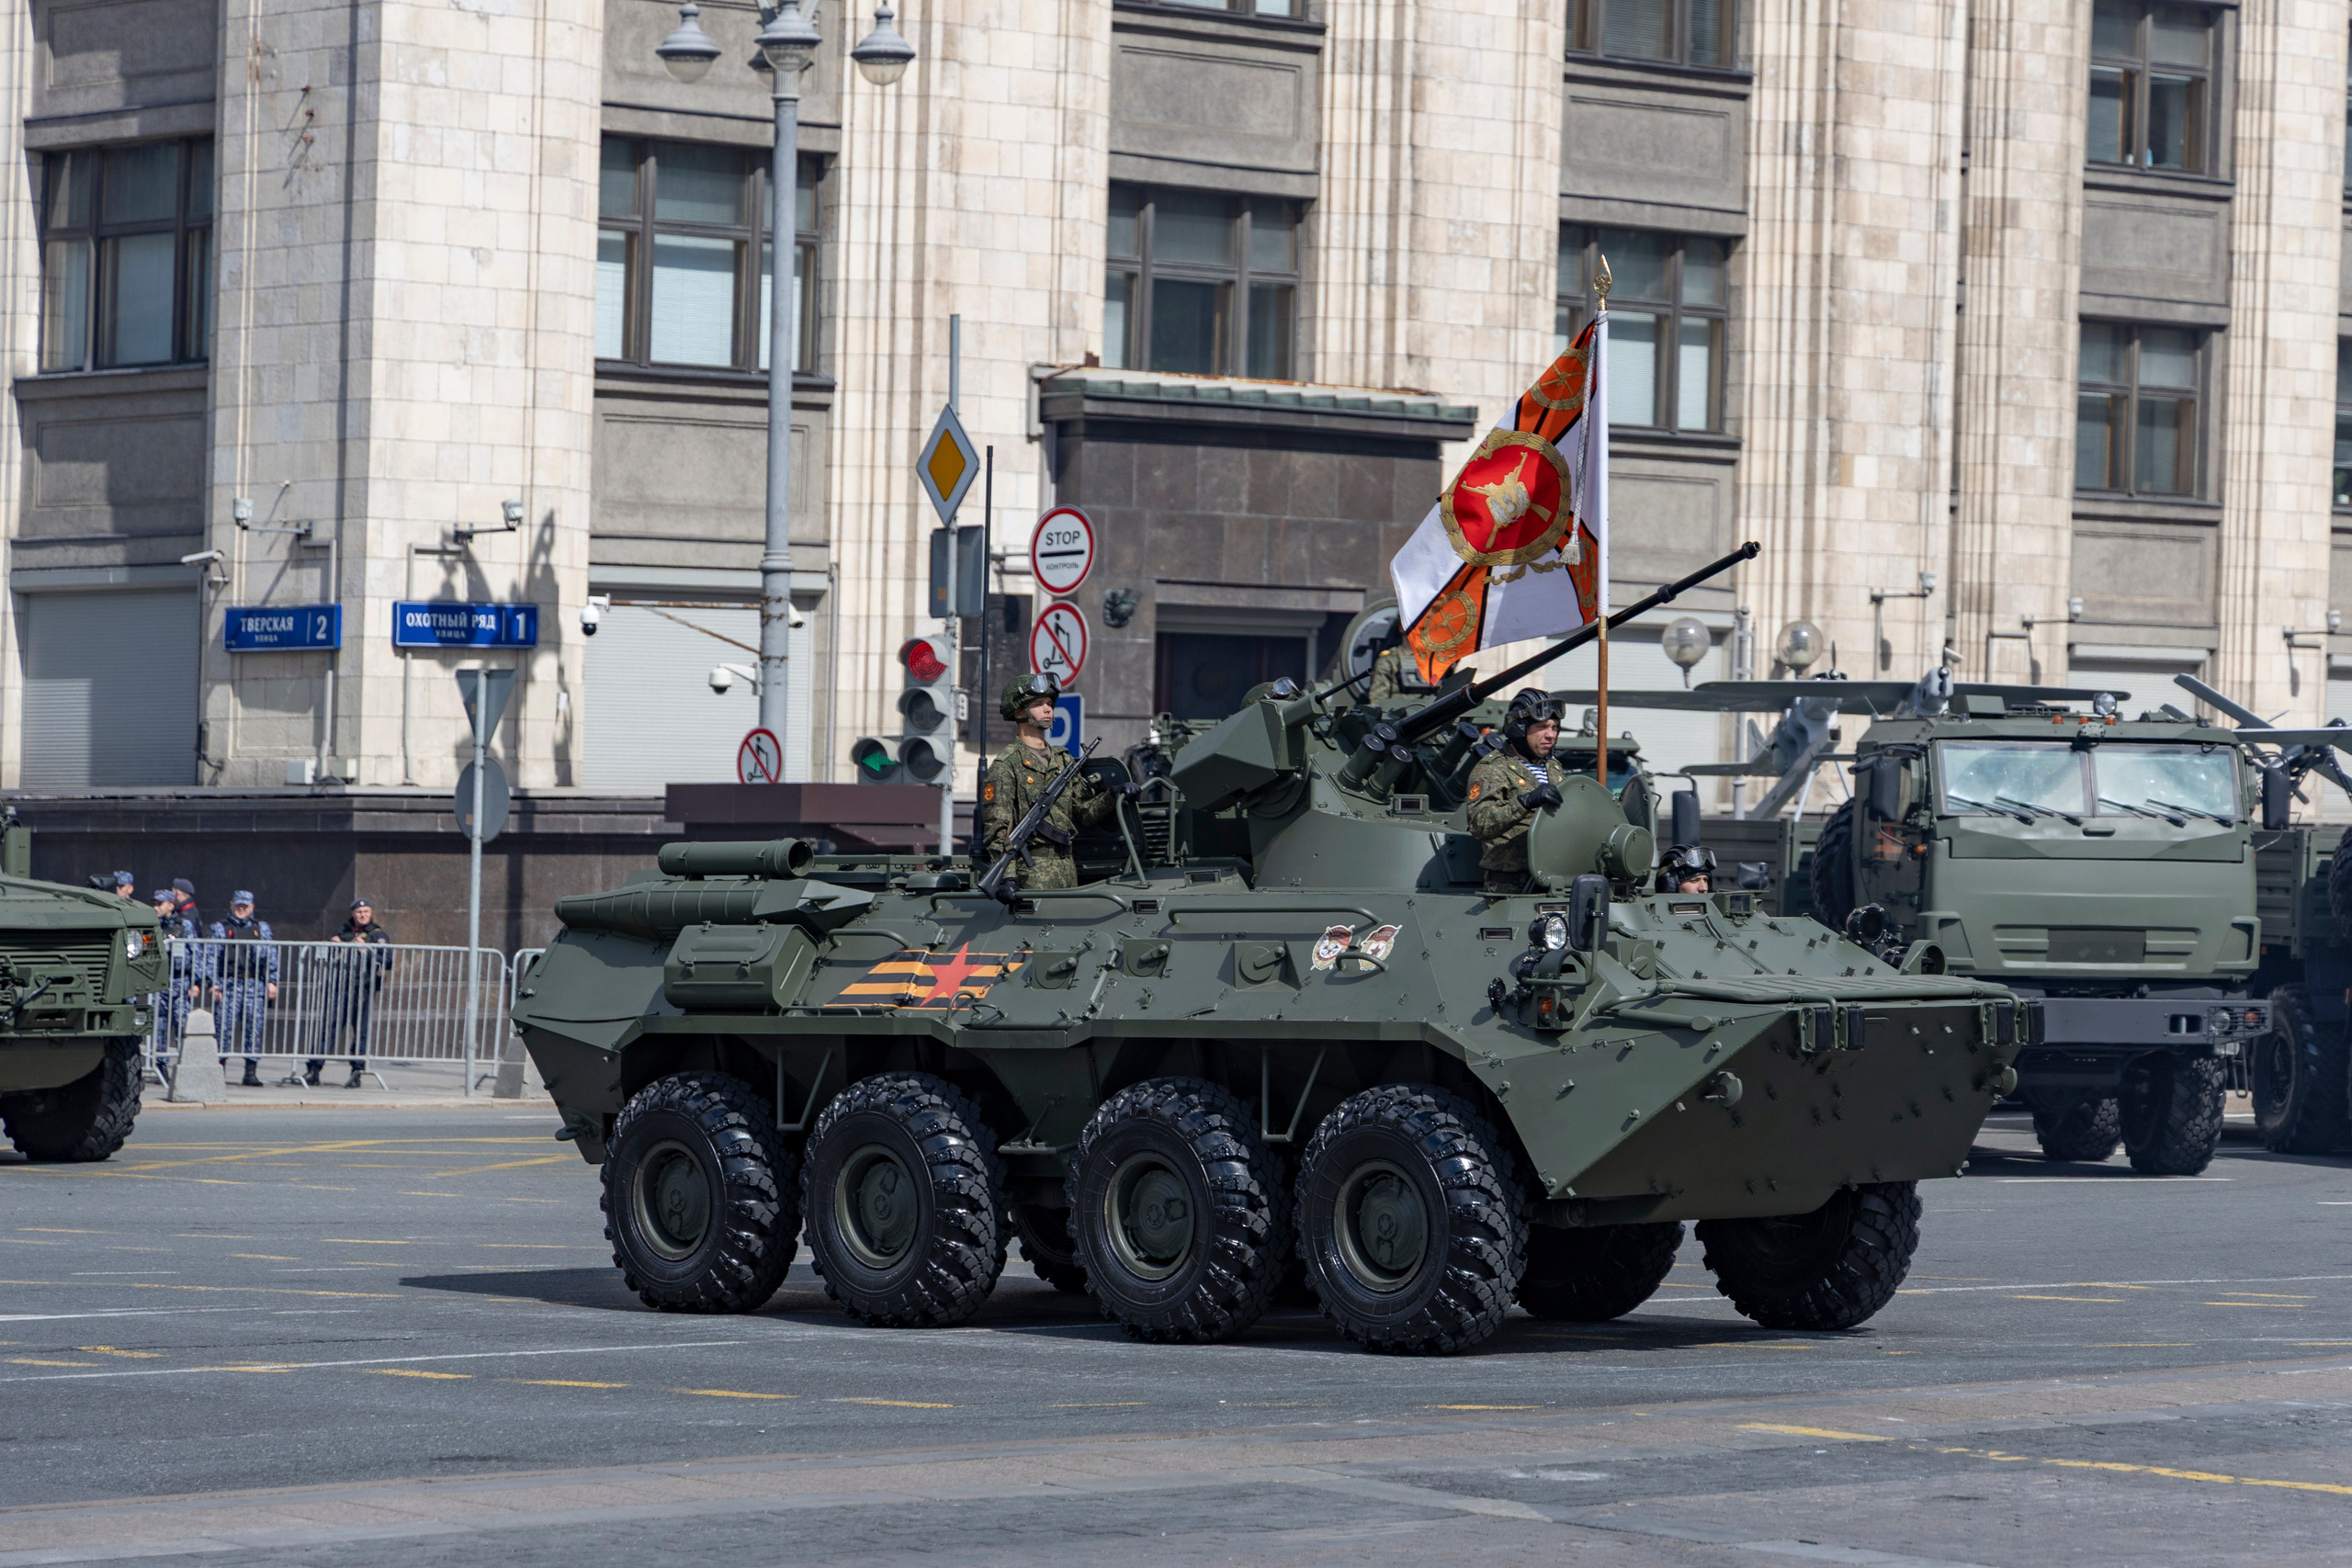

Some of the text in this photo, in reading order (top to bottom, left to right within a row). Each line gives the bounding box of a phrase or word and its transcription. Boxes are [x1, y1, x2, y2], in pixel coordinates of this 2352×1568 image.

[1046, 530, 1080, 546] STOP
[1046, 561, 1080, 570] КОНТРОЛЬ
[240, 615, 328, 640] ТВЕРСКАЯ 2
[405, 611, 526, 640] ОХОТНЫЙ РЯД 1
[435, 629, 467, 639] УЛИЦА
